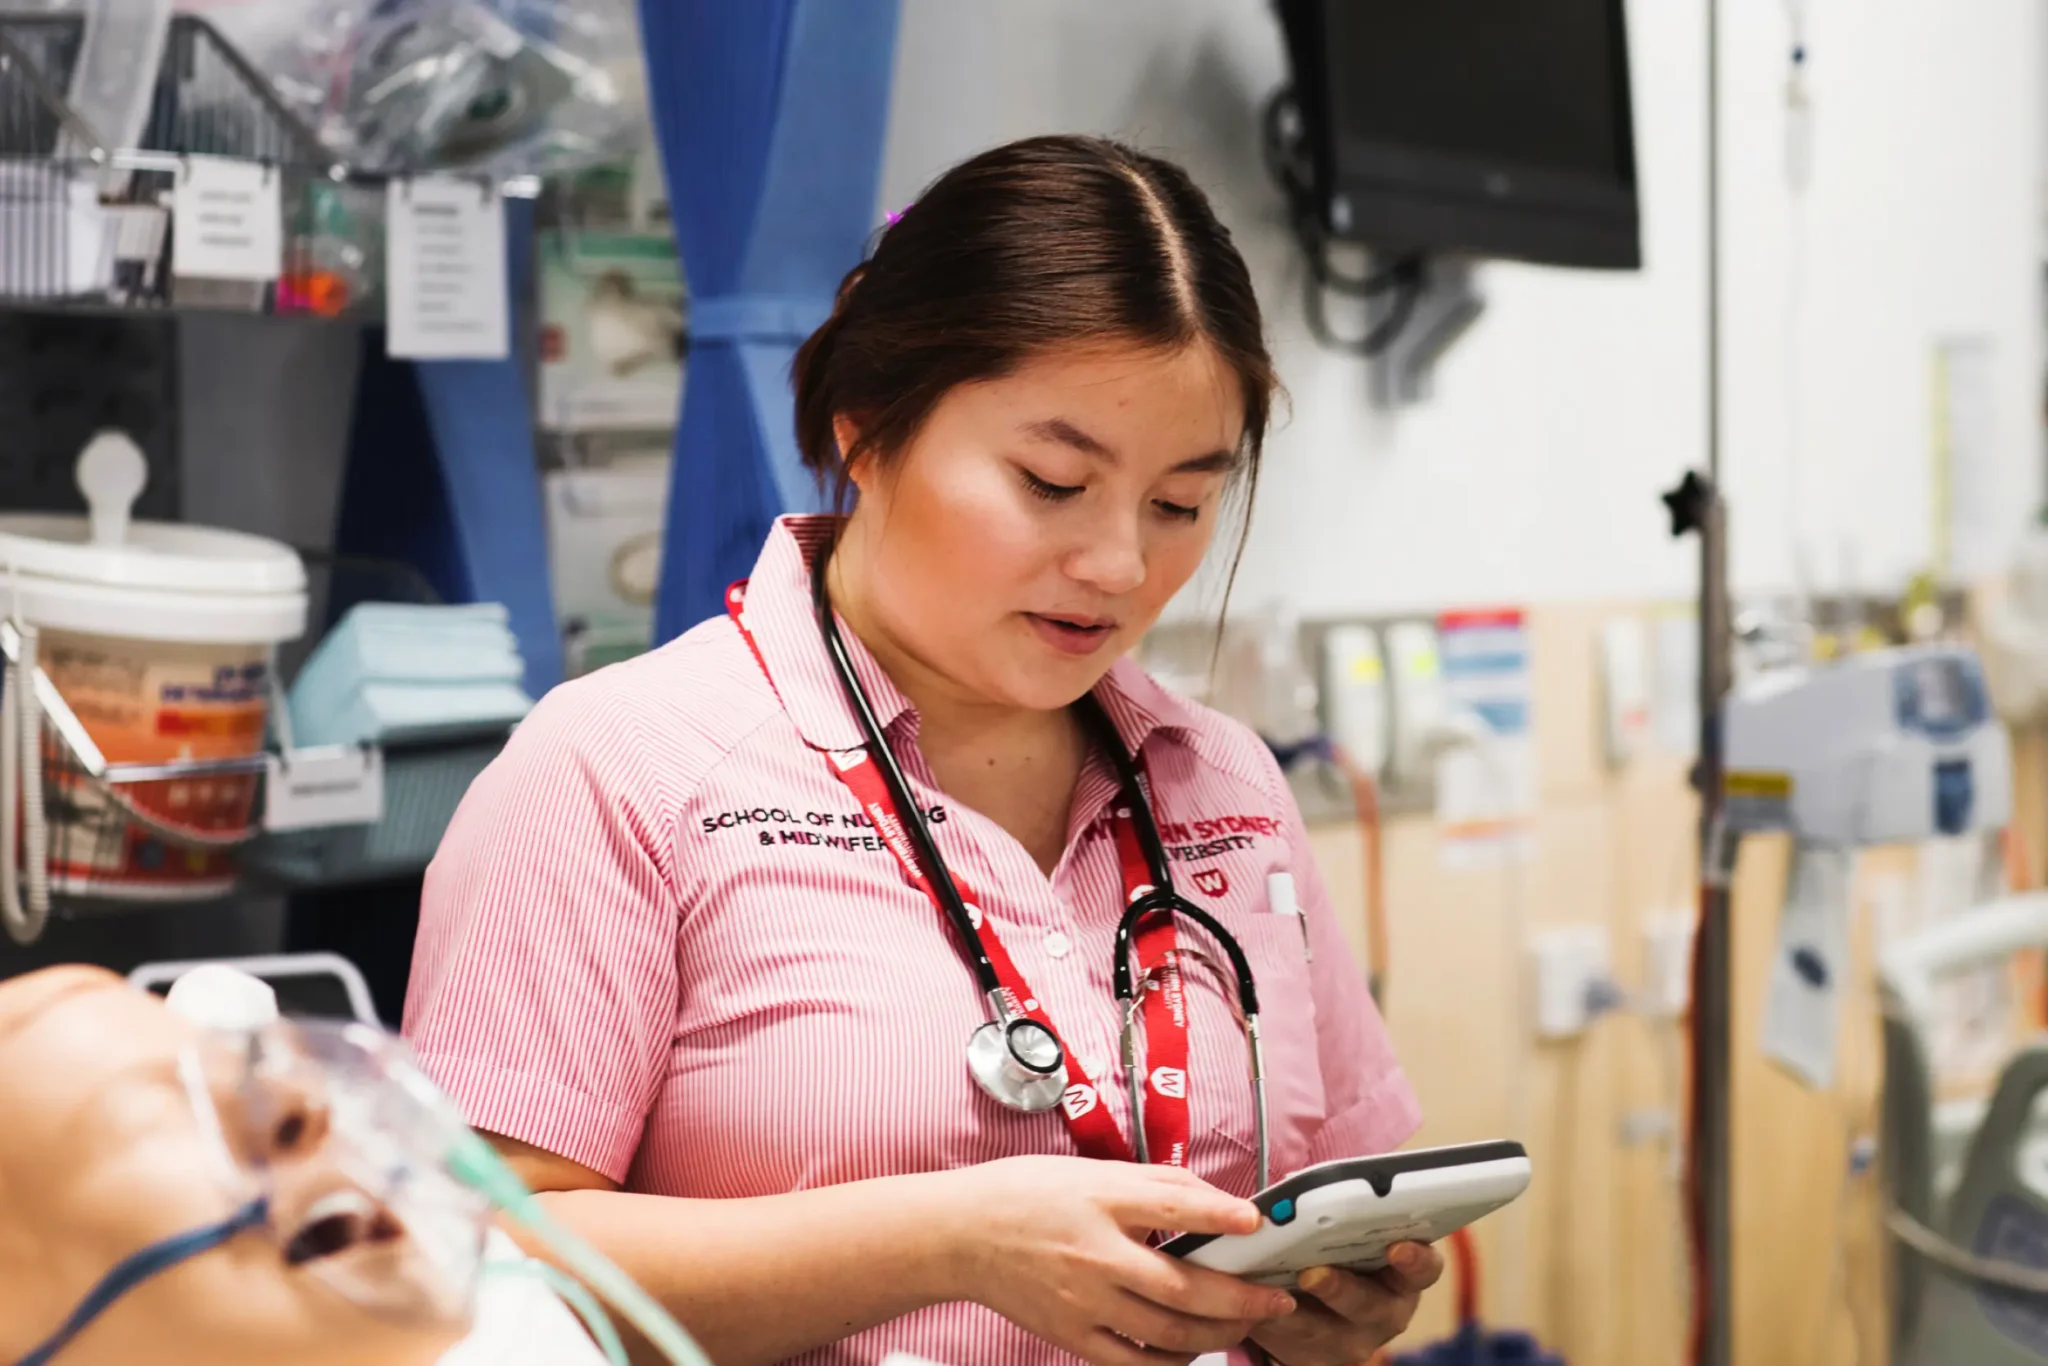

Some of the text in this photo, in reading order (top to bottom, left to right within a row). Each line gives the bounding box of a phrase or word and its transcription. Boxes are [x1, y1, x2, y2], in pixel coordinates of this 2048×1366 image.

[702, 808, 801, 833] SCHOOL
[806, 812, 834, 827] OF
[1193, 815, 1282, 839] SYDNEY
[759, 831, 890, 851] & MIDWIFER
[1163, 836, 1255, 861] VERSITY
